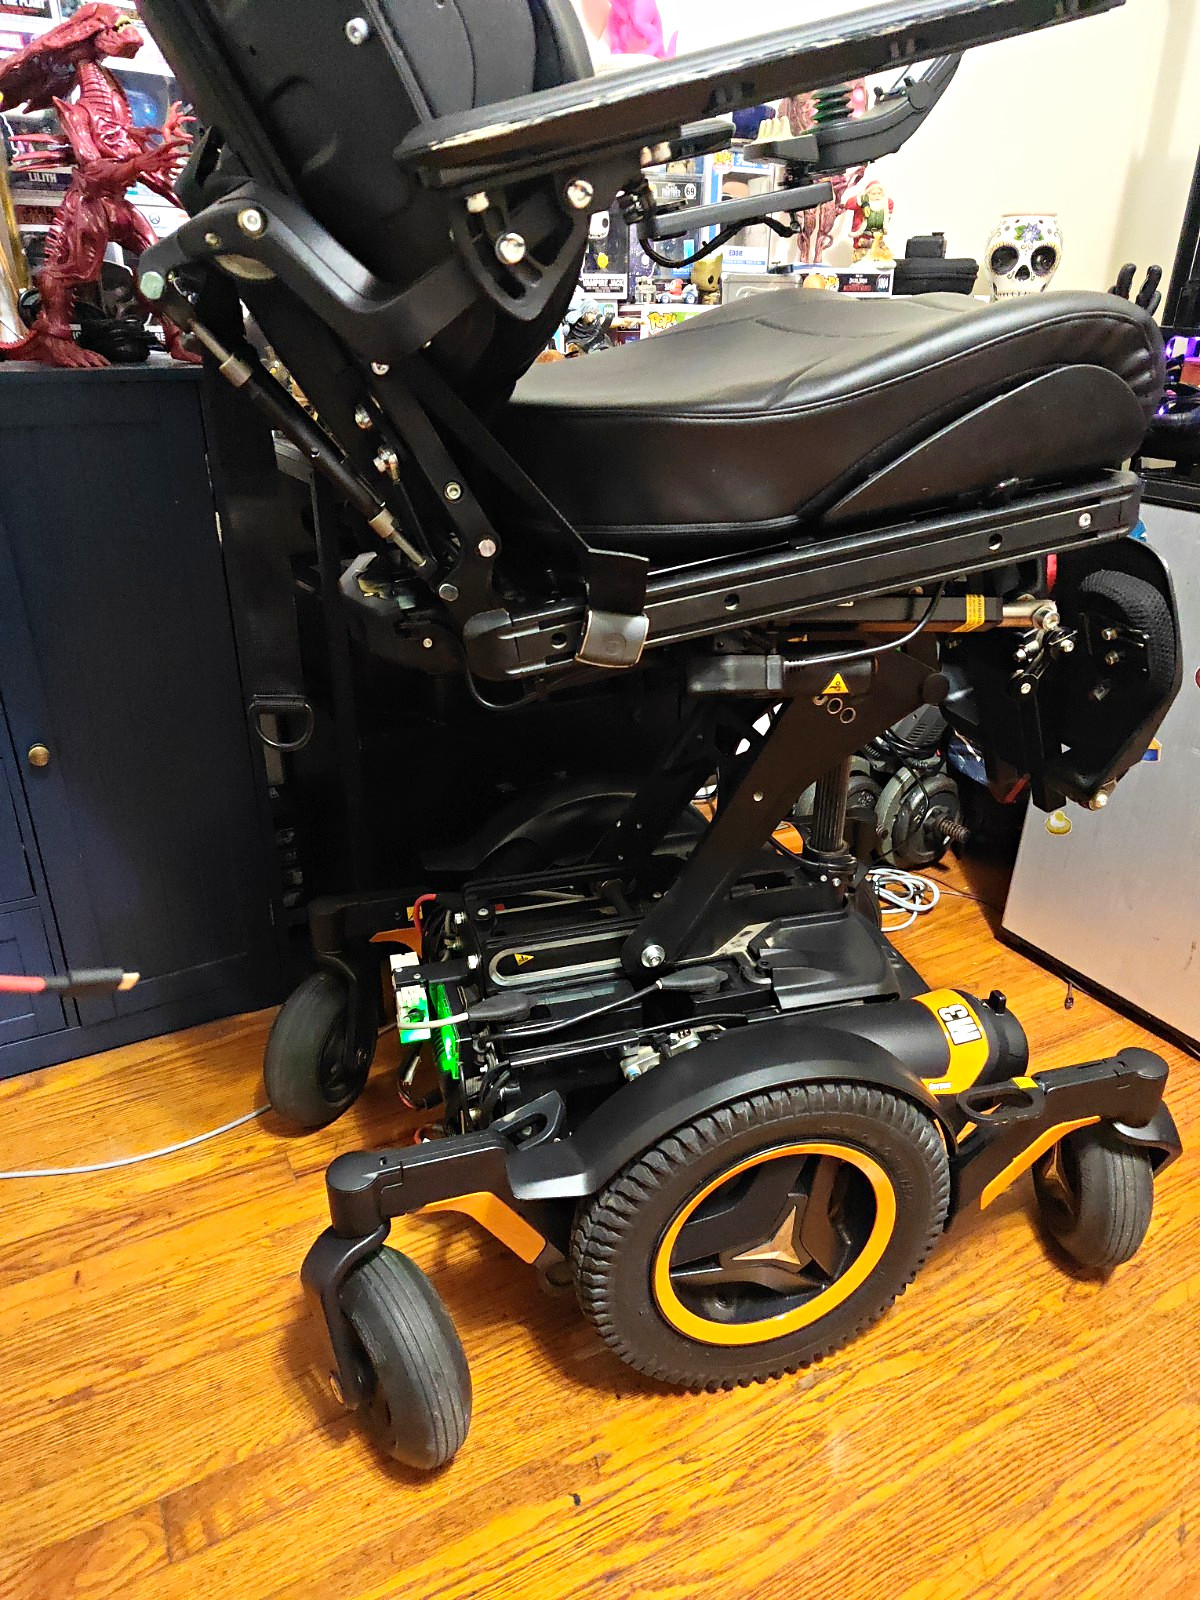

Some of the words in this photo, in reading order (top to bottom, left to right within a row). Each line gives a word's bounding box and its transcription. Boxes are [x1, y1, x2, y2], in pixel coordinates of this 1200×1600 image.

[28, 172, 57, 183] LILITH
[728, 249, 744, 257] EDDIE
[610, 279, 625, 287] JACK
[647, 312, 678, 330] POP!
[938, 1003, 982, 1046] M3
